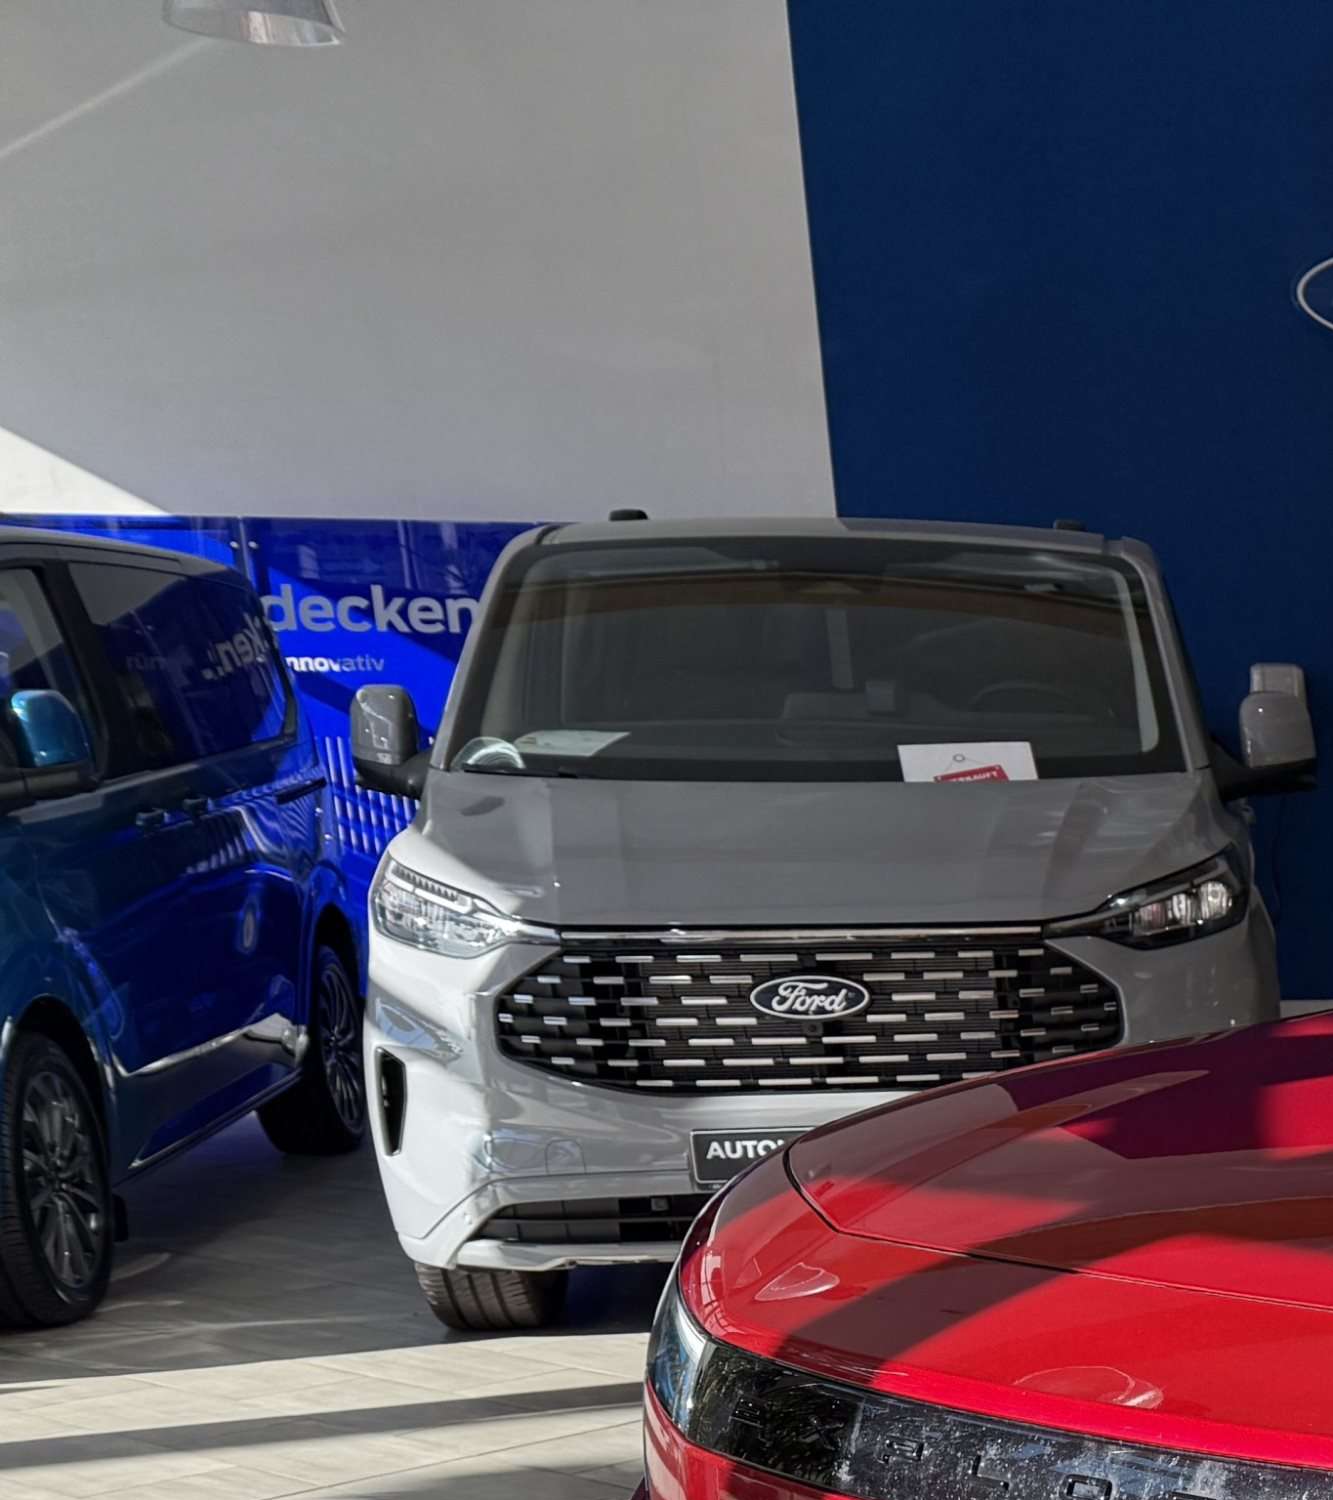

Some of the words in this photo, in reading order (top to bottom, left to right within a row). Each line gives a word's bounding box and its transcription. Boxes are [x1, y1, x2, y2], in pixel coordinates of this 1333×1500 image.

[259, 583, 484, 635] decken
[771, 981, 848, 1012] Ford
[706, 1138, 785, 1160] AUTO
